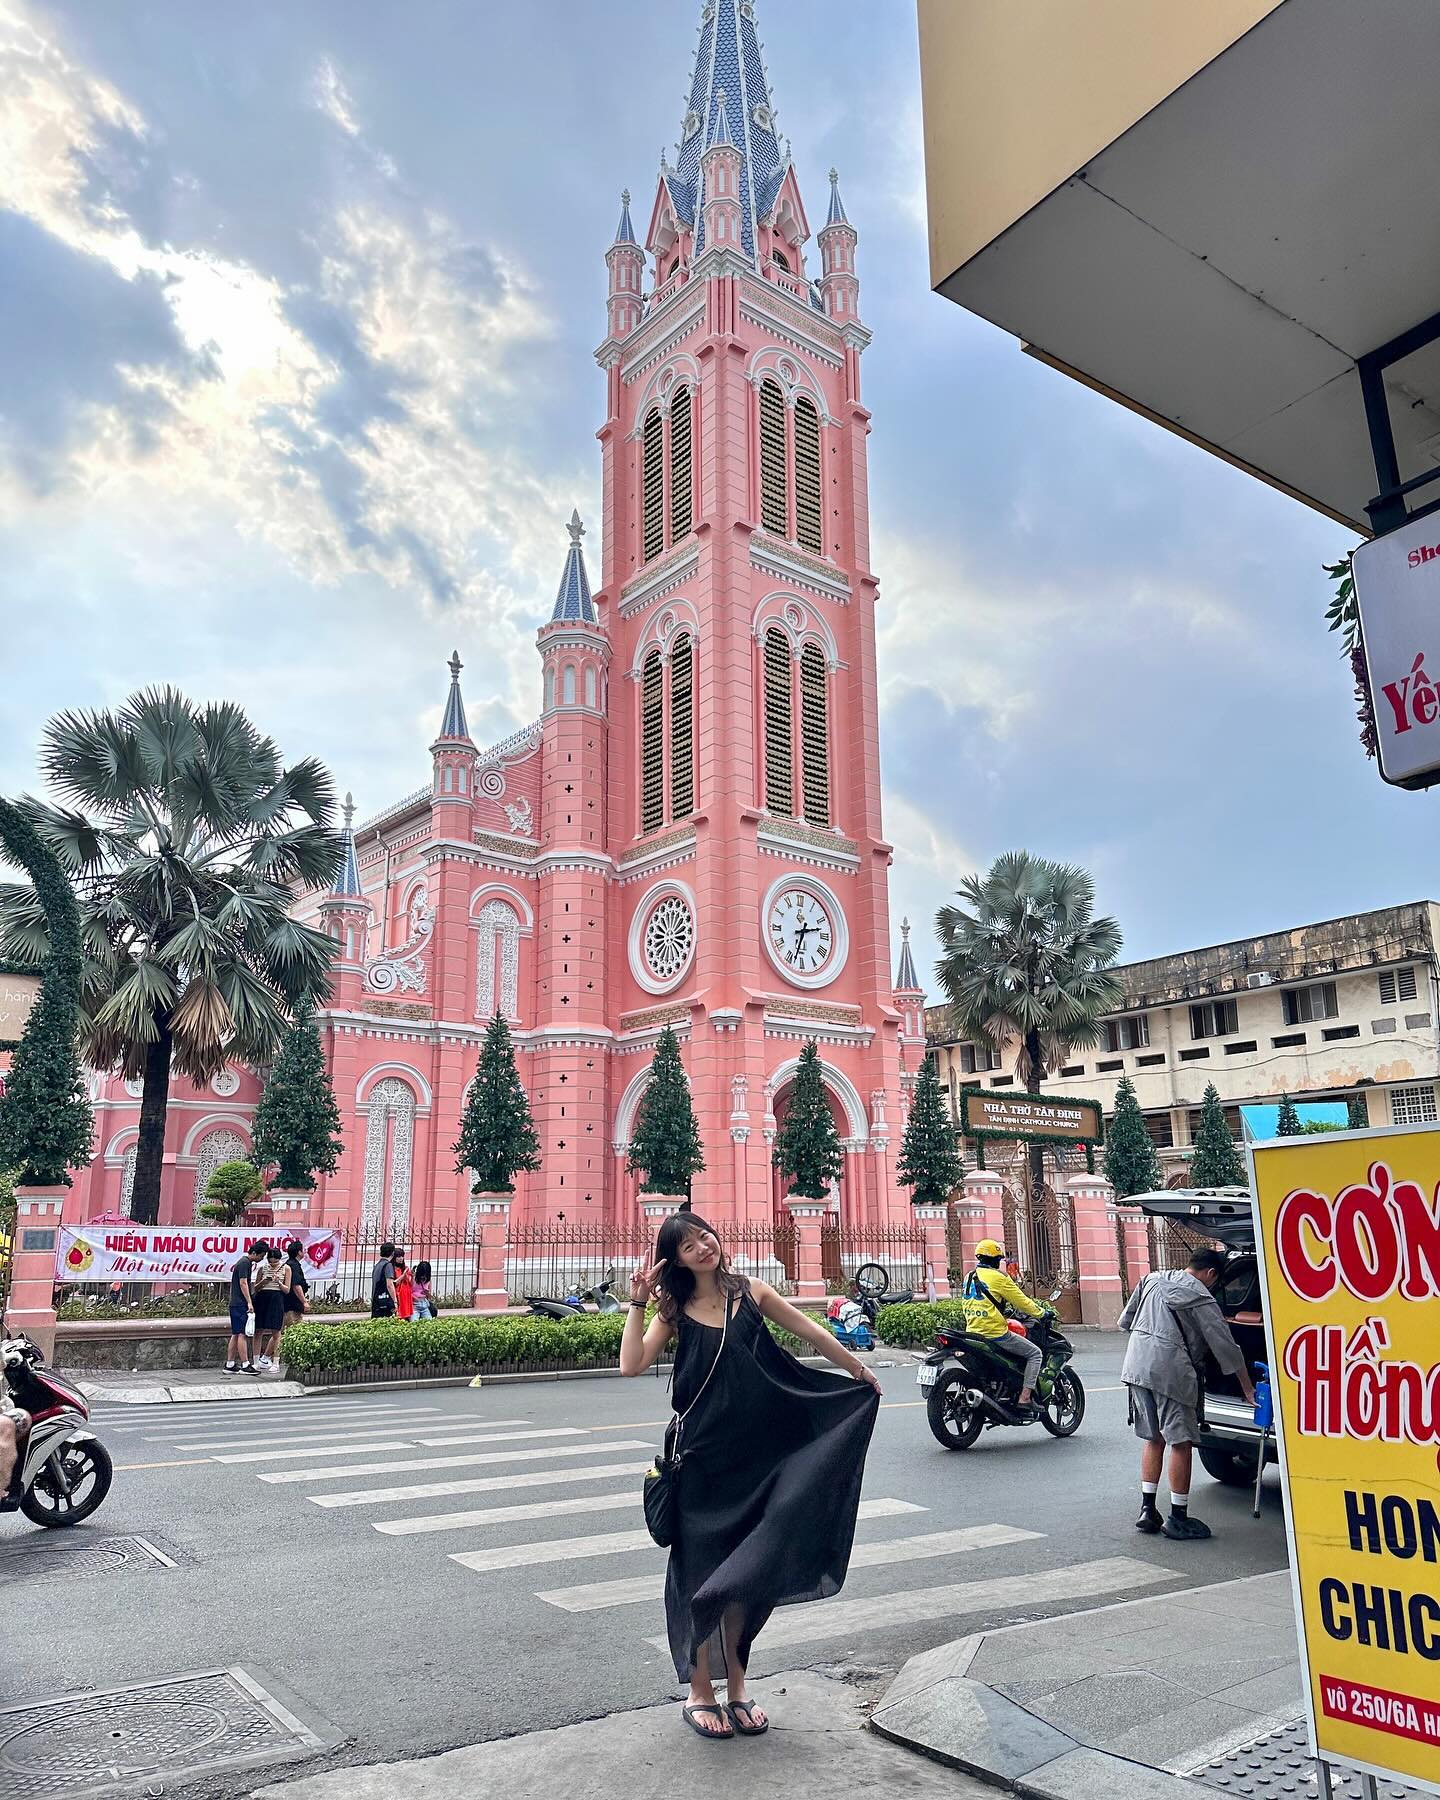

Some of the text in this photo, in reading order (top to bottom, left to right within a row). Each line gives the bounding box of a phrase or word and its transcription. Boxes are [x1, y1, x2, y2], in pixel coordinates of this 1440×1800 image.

[983, 1101, 1082, 1120] NHÀ THỜ TÂN ĐỊNH
[1020, 1118, 1052, 1126] CATHOLIC
[1053, 1121, 1079, 1129] CHURCH
[105, 1230, 147, 1252] HIẾN
[153, 1233, 196, 1253] MÁU
[202, 1234, 238, 1253] CỨU
[105, 1256, 144, 1275] Một
[150, 1258, 200, 1275] nghĩa
[205, 1260, 226, 1272] cử
[1283, 1316, 1440, 1470] Hồn
[1319, 1577, 1440, 1661] CHIC
[1326, 1685, 1346, 1712] VÔ
[1351, 1688, 1420, 1732] 250/6A
